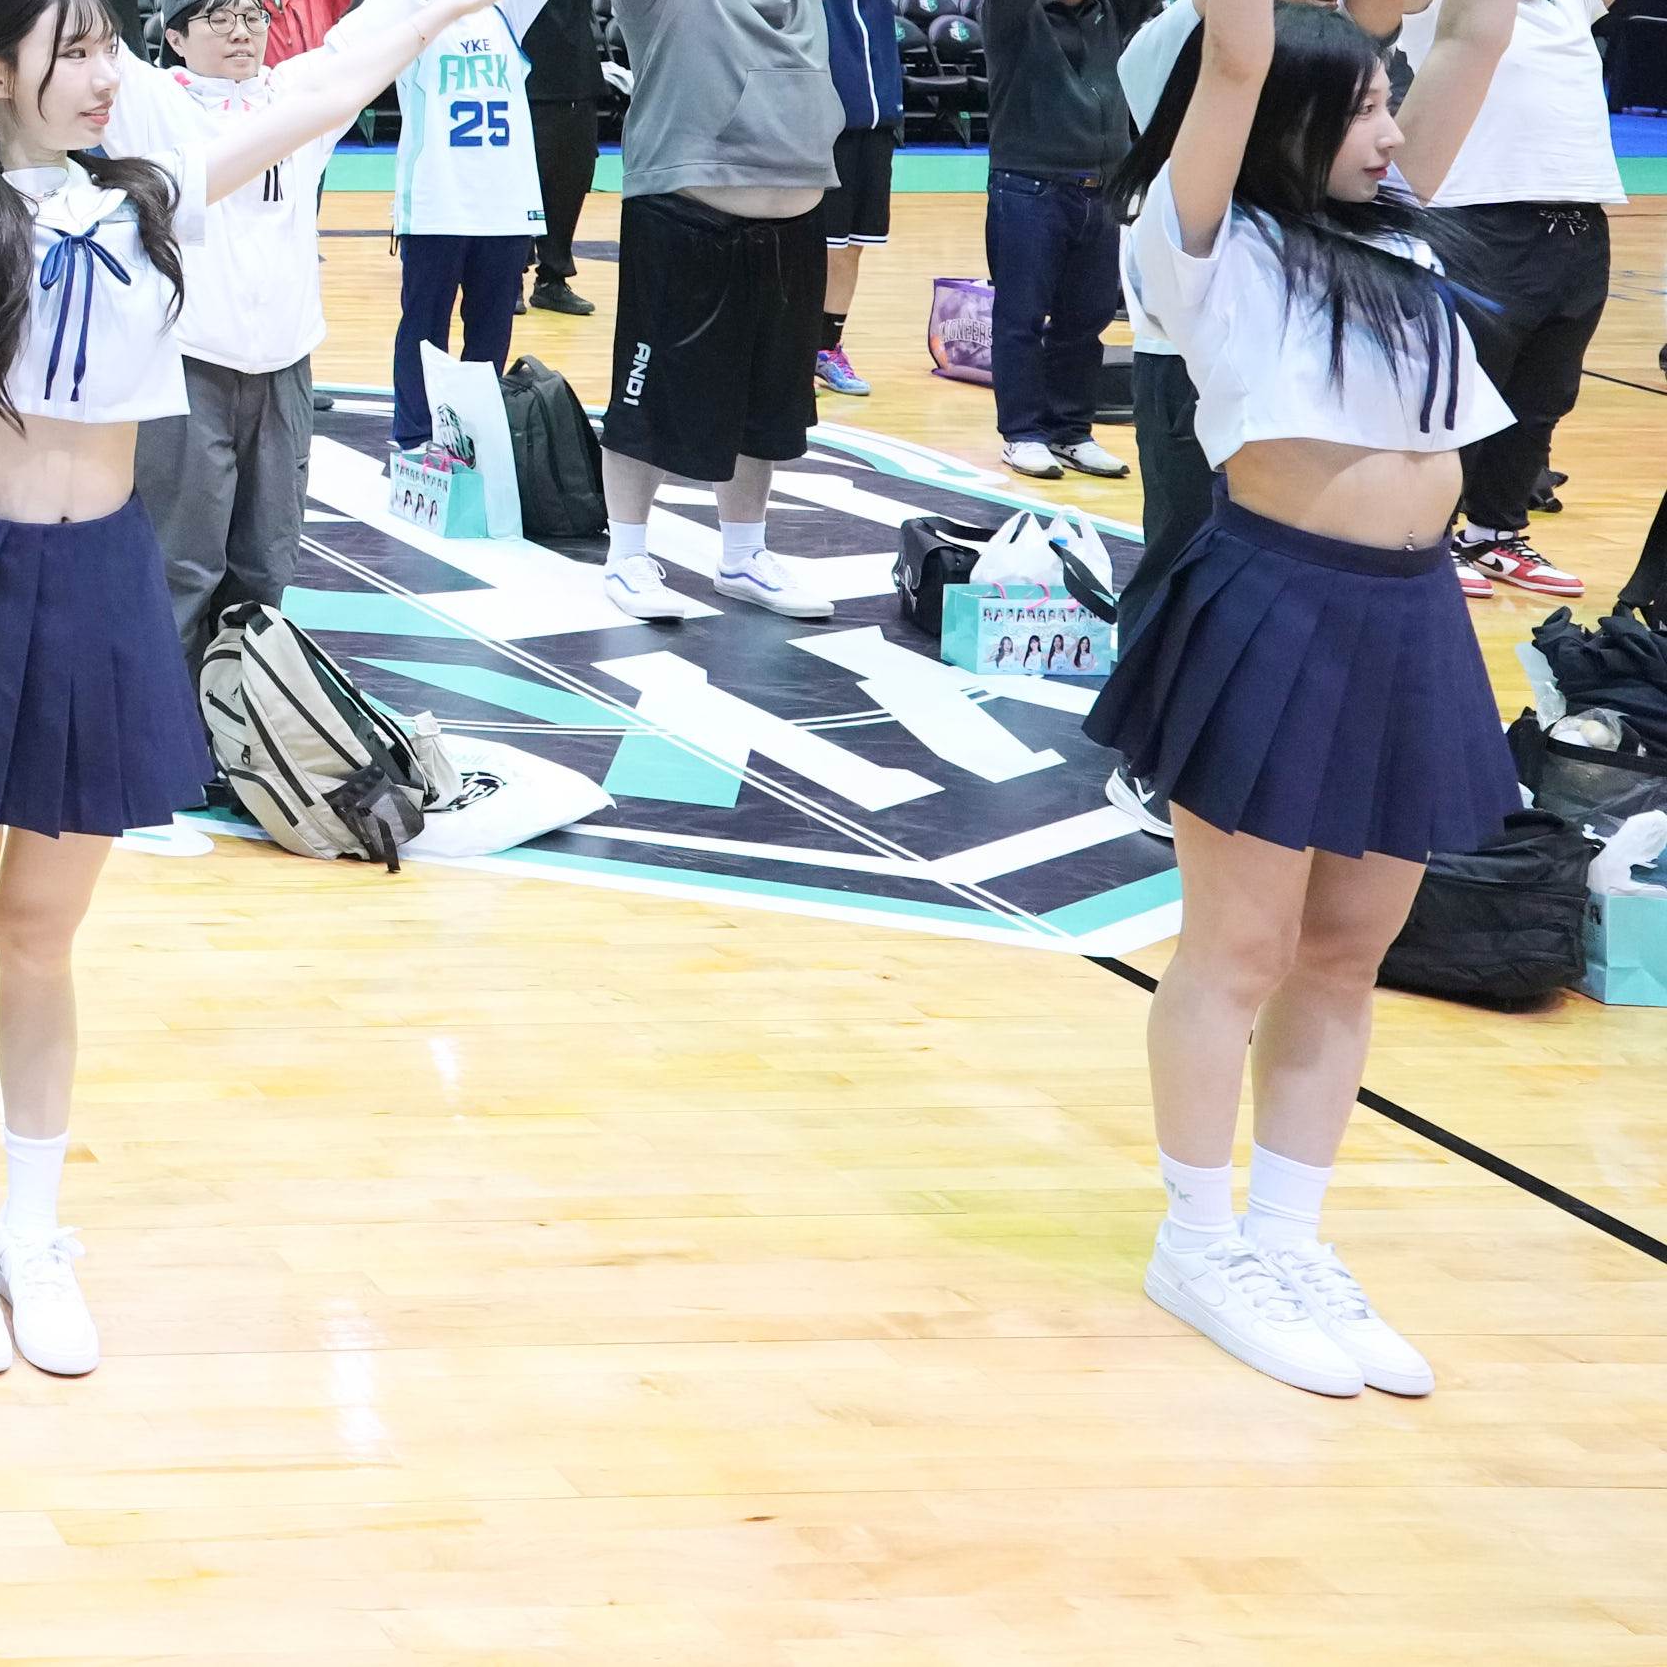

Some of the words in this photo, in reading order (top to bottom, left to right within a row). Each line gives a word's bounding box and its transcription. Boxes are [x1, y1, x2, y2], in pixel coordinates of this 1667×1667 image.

[459, 38, 491, 54] YKE
[438, 53, 512, 96] ARK
[449, 100, 511, 147] 25
